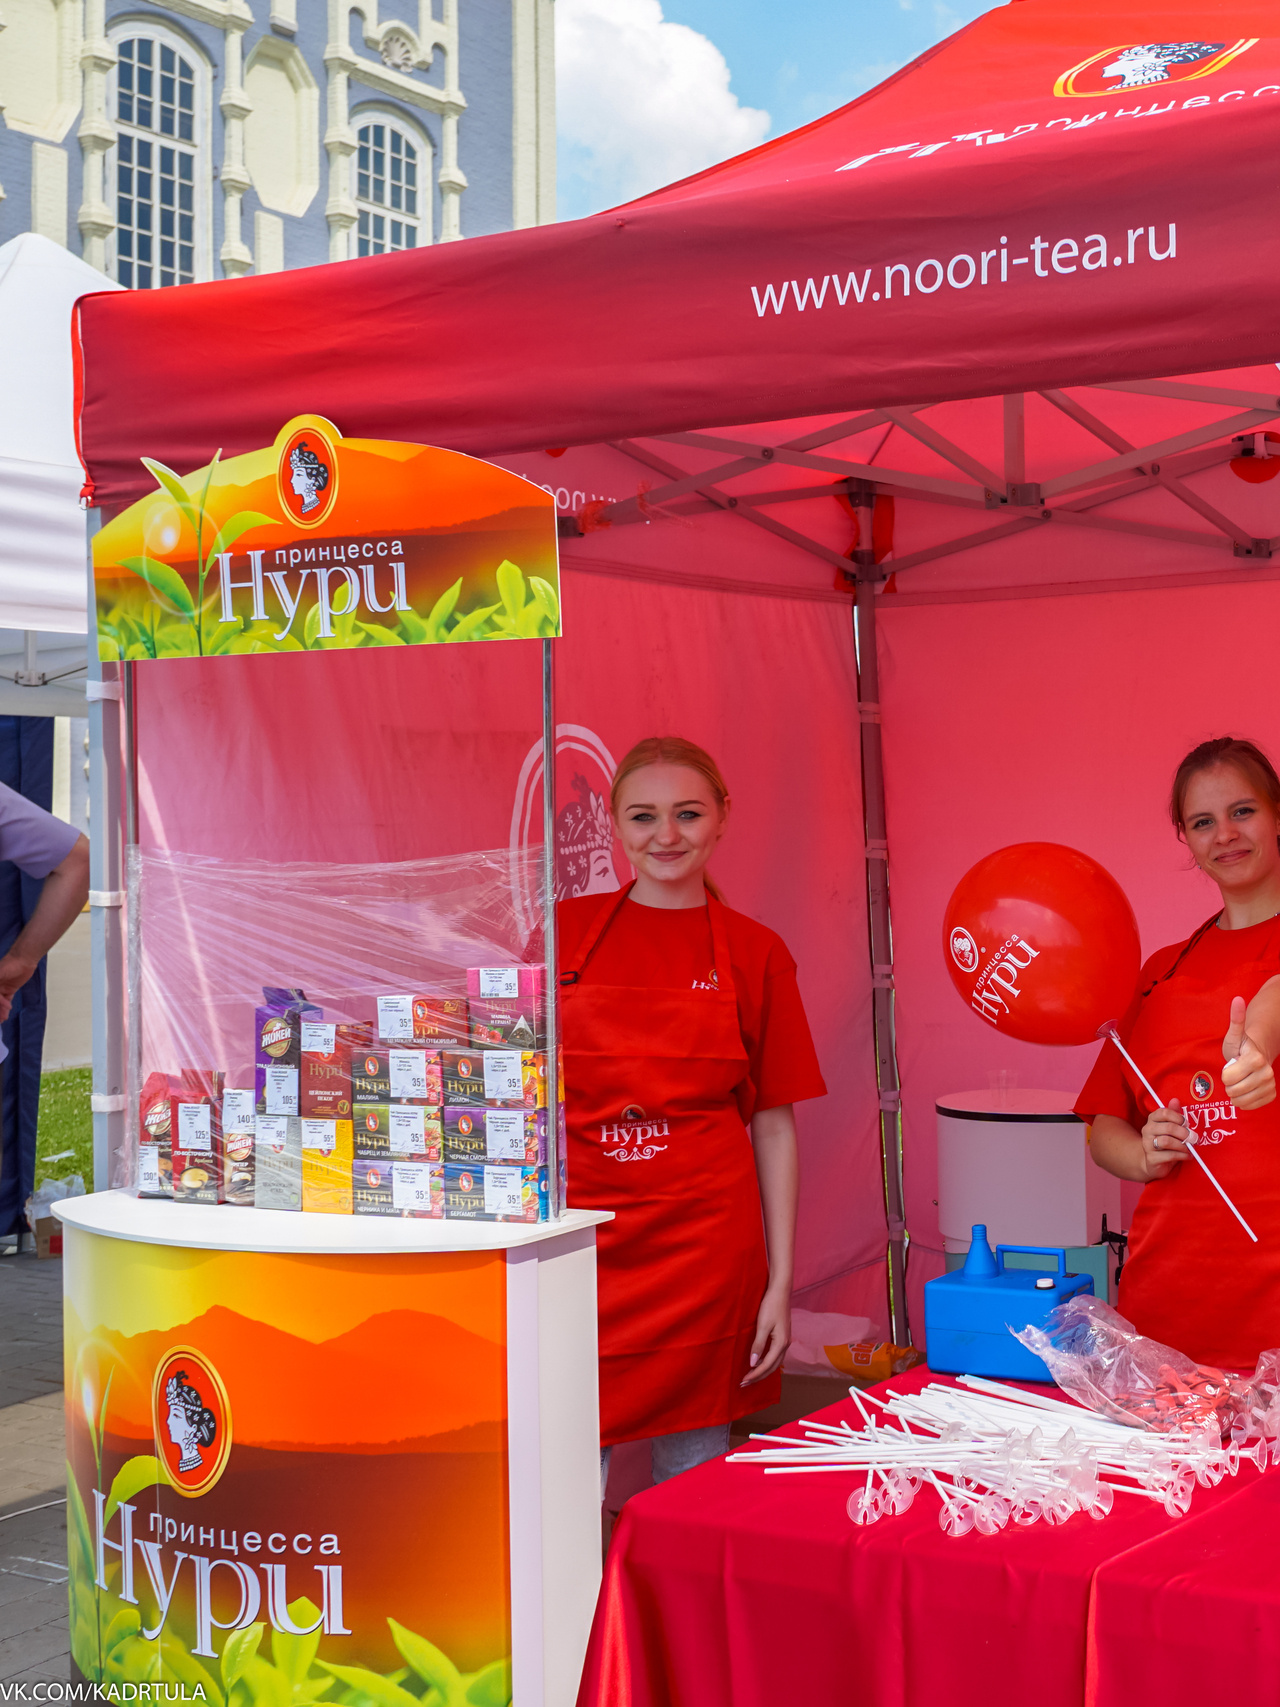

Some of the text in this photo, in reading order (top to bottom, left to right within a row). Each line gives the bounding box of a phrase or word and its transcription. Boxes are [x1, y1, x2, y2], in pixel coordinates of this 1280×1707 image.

[751, 222, 1178, 317] www.noori-tea.ru
[275, 540, 403, 567] принцесса
[214, 550, 412, 641] Нури
[975, 934, 1019, 990] принцесса
[971, 939, 1040, 1025] Нури
[400, 1018, 408, 1028] 35
[414, 1022, 438, 1036] ури
[412, 1078, 421, 1087] 35
[507, 1078, 517, 1088] 35
[282, 1095, 294, 1105] 105
[1190, 1101, 1233, 1110] принцесс
[237, 1114, 250, 1124] 140
[621, 1118, 668, 1128] принцесса
[195, 1130, 206, 1140] 125
[410, 1133, 420, 1143] 35
[600, 1120, 670, 1147] Нури
[510, 1139, 519, 1148] 35
[415, 1190, 425, 1200] 35
[507, 1195, 516, 1204] 35
[150, 1511, 341, 1555] принцесса
[92, 1488, 352, 1659] Нури
